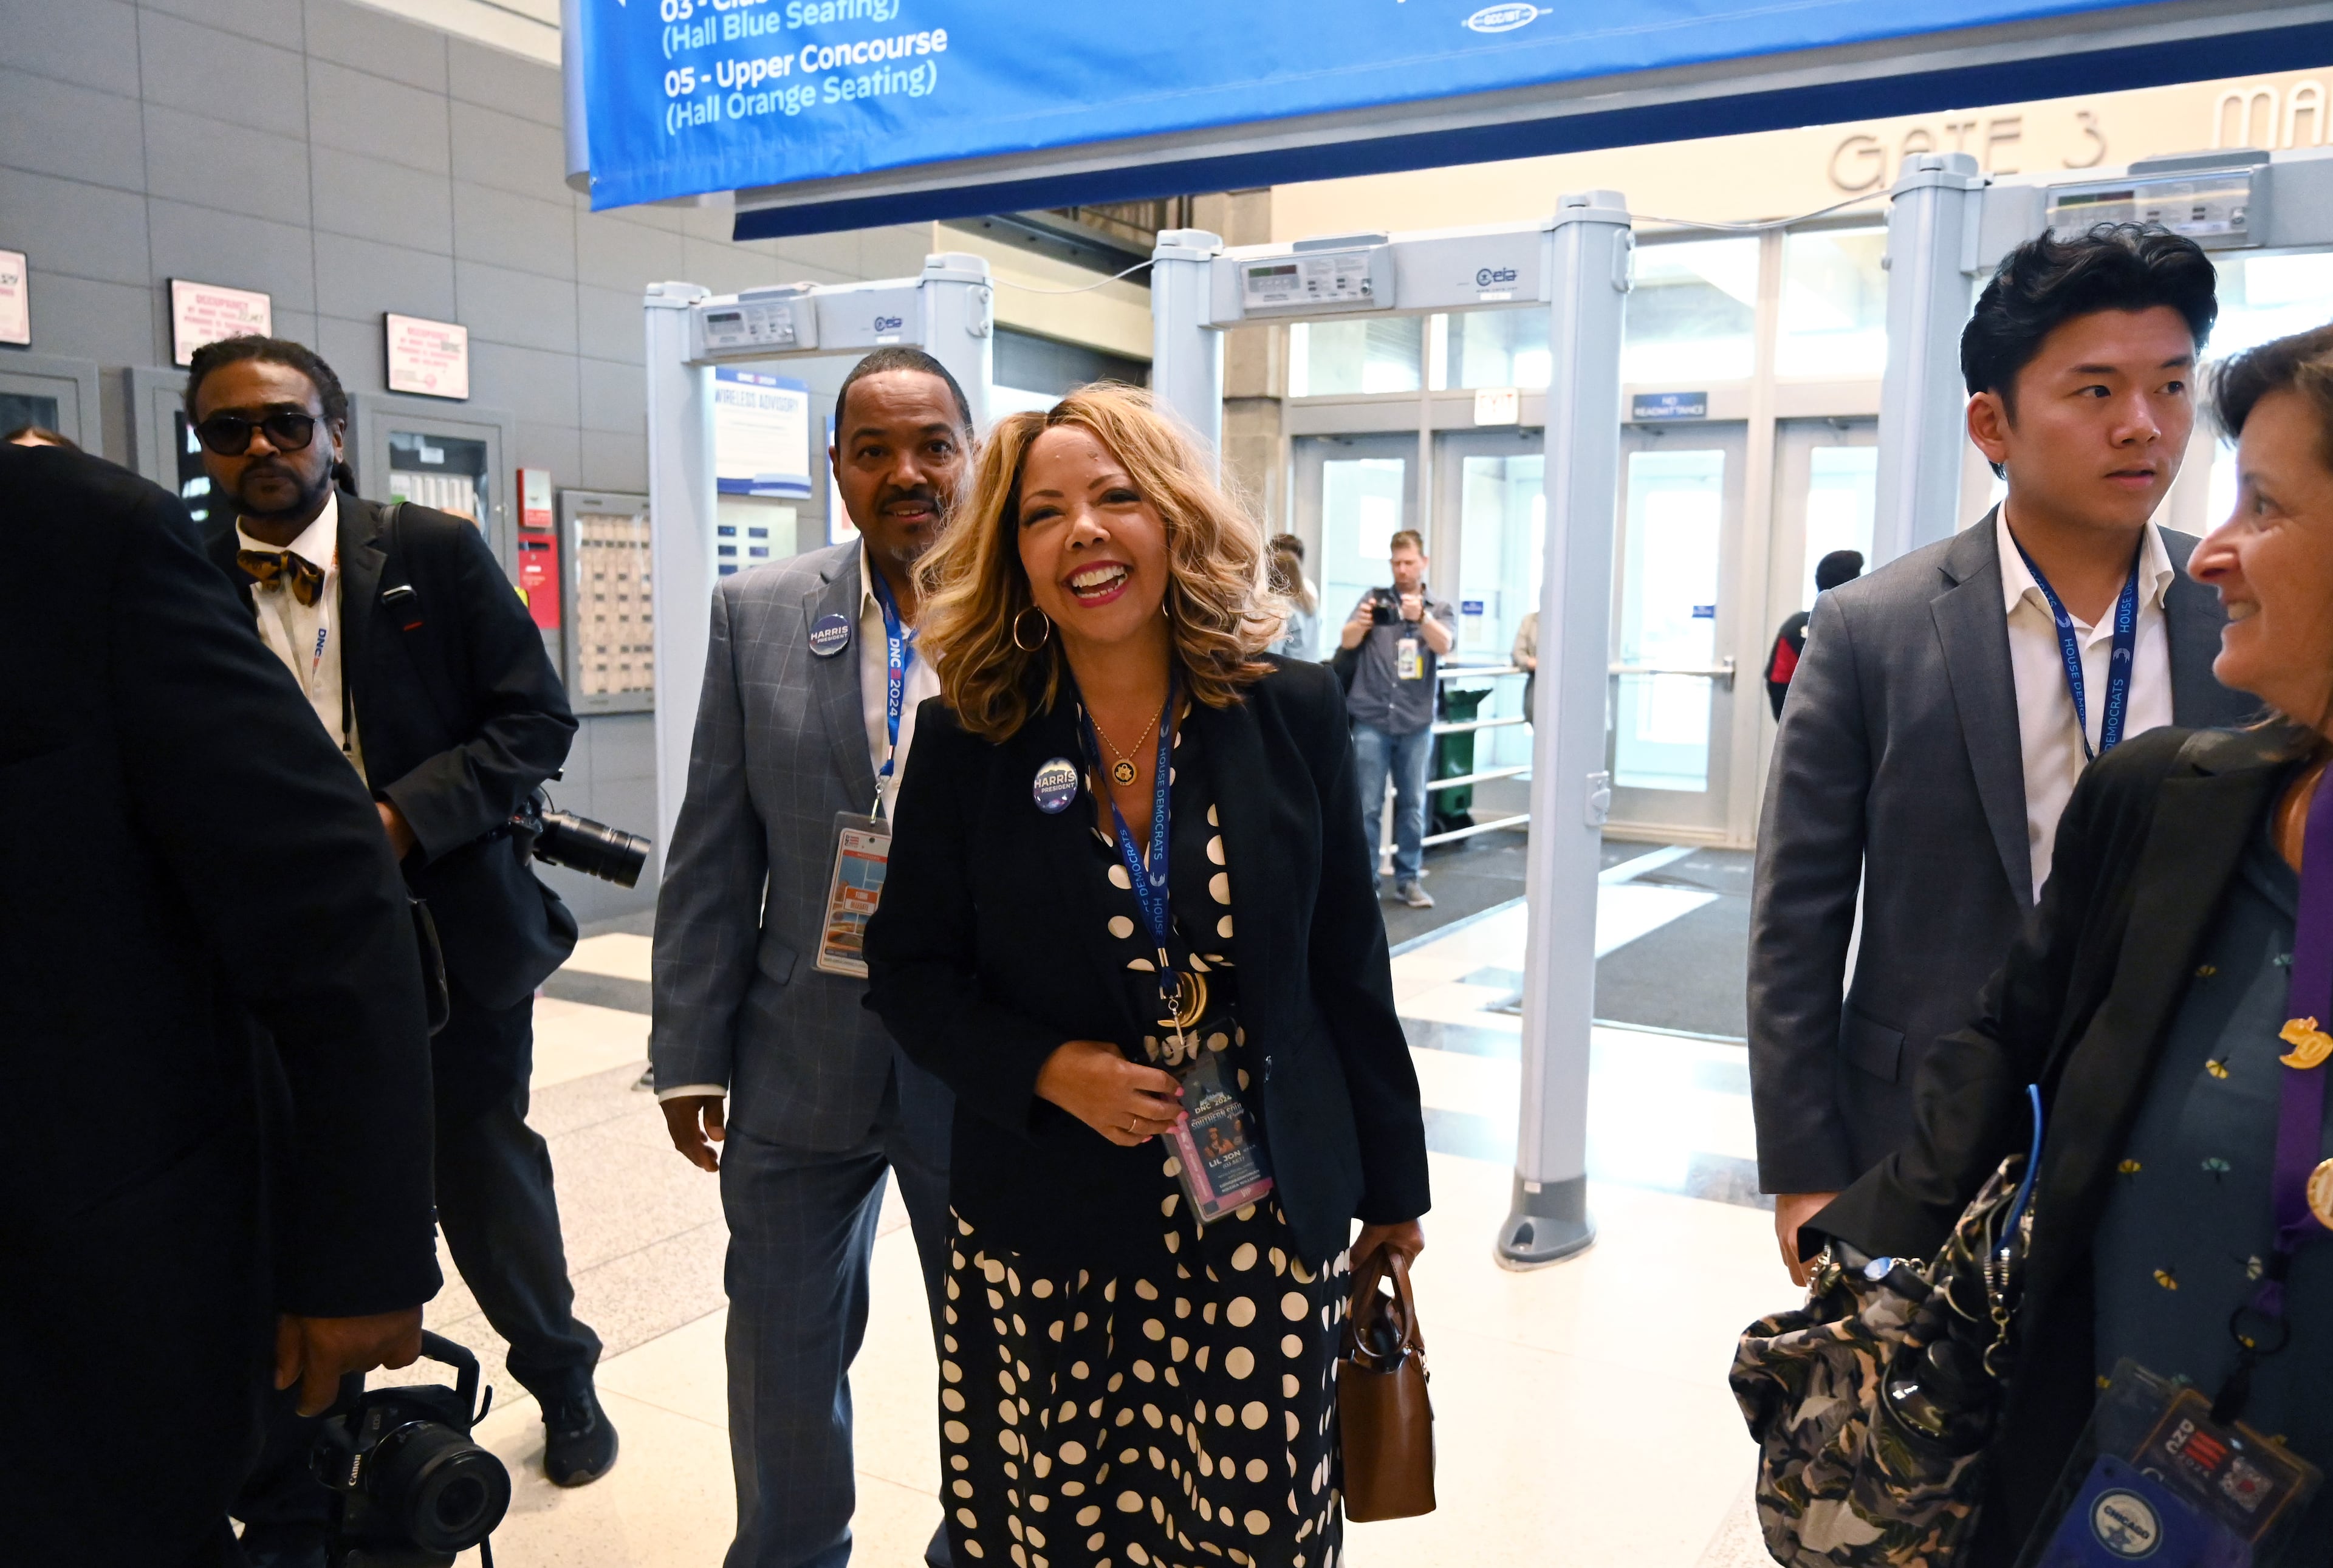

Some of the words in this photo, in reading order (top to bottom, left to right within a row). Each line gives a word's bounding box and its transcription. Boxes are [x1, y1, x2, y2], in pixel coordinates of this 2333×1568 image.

[662, 16, 716, 60] (Hall
[723, 11, 780, 41] Blue
[786, 0, 900, 29] Seating)
[665, 67, 696, 97] 05
[716, 53, 795, 91] Upper
[800, 29, 948, 73] Concourse
[666, 95, 720, 135] (Hall
[727, 84, 816, 120] Orange
[822, 60, 937, 104] Seating)
[2210, 81, 2333, 150] MA
[2062, 110, 2106, 169] 3
[810, 625, 848, 641] HARRIS
[2120, 597, 2132, 633] HOUSE
[315, 628, 327, 657] DNC
[817, 633, 848, 643] PRESIDENT
[889, 637, 902, 668] DNC
[2064, 638, 2080, 679] HOUSE
[889, 679, 901, 717] 2024
[2104, 678, 2123, 752] DEMOCRATS
[1034, 770, 1075, 789] HARRIS
[1156, 747, 1166, 787] HOUSE
[1041, 782, 1075, 793] PRESIDENT
[1154, 790, 1165, 861] DEMOCRATS
[1119, 829, 1149, 899] DEMOCRATS
[1153, 897, 1163, 936] HOUSE
[1191, 1109, 1226, 1130] SOUTHERN
[1194, 1103, 1211, 1114] DNC
[1214, 1095, 1232, 1106] 2024
[1208, 1158, 1222, 1168] LIL
[1223, 1149, 1241, 1162] JON
[1240, 1188, 1252, 1198] VIP
[349, 1454, 361, 1487] Canon
[2103, 1505, 2150, 1541] CHICAGO
